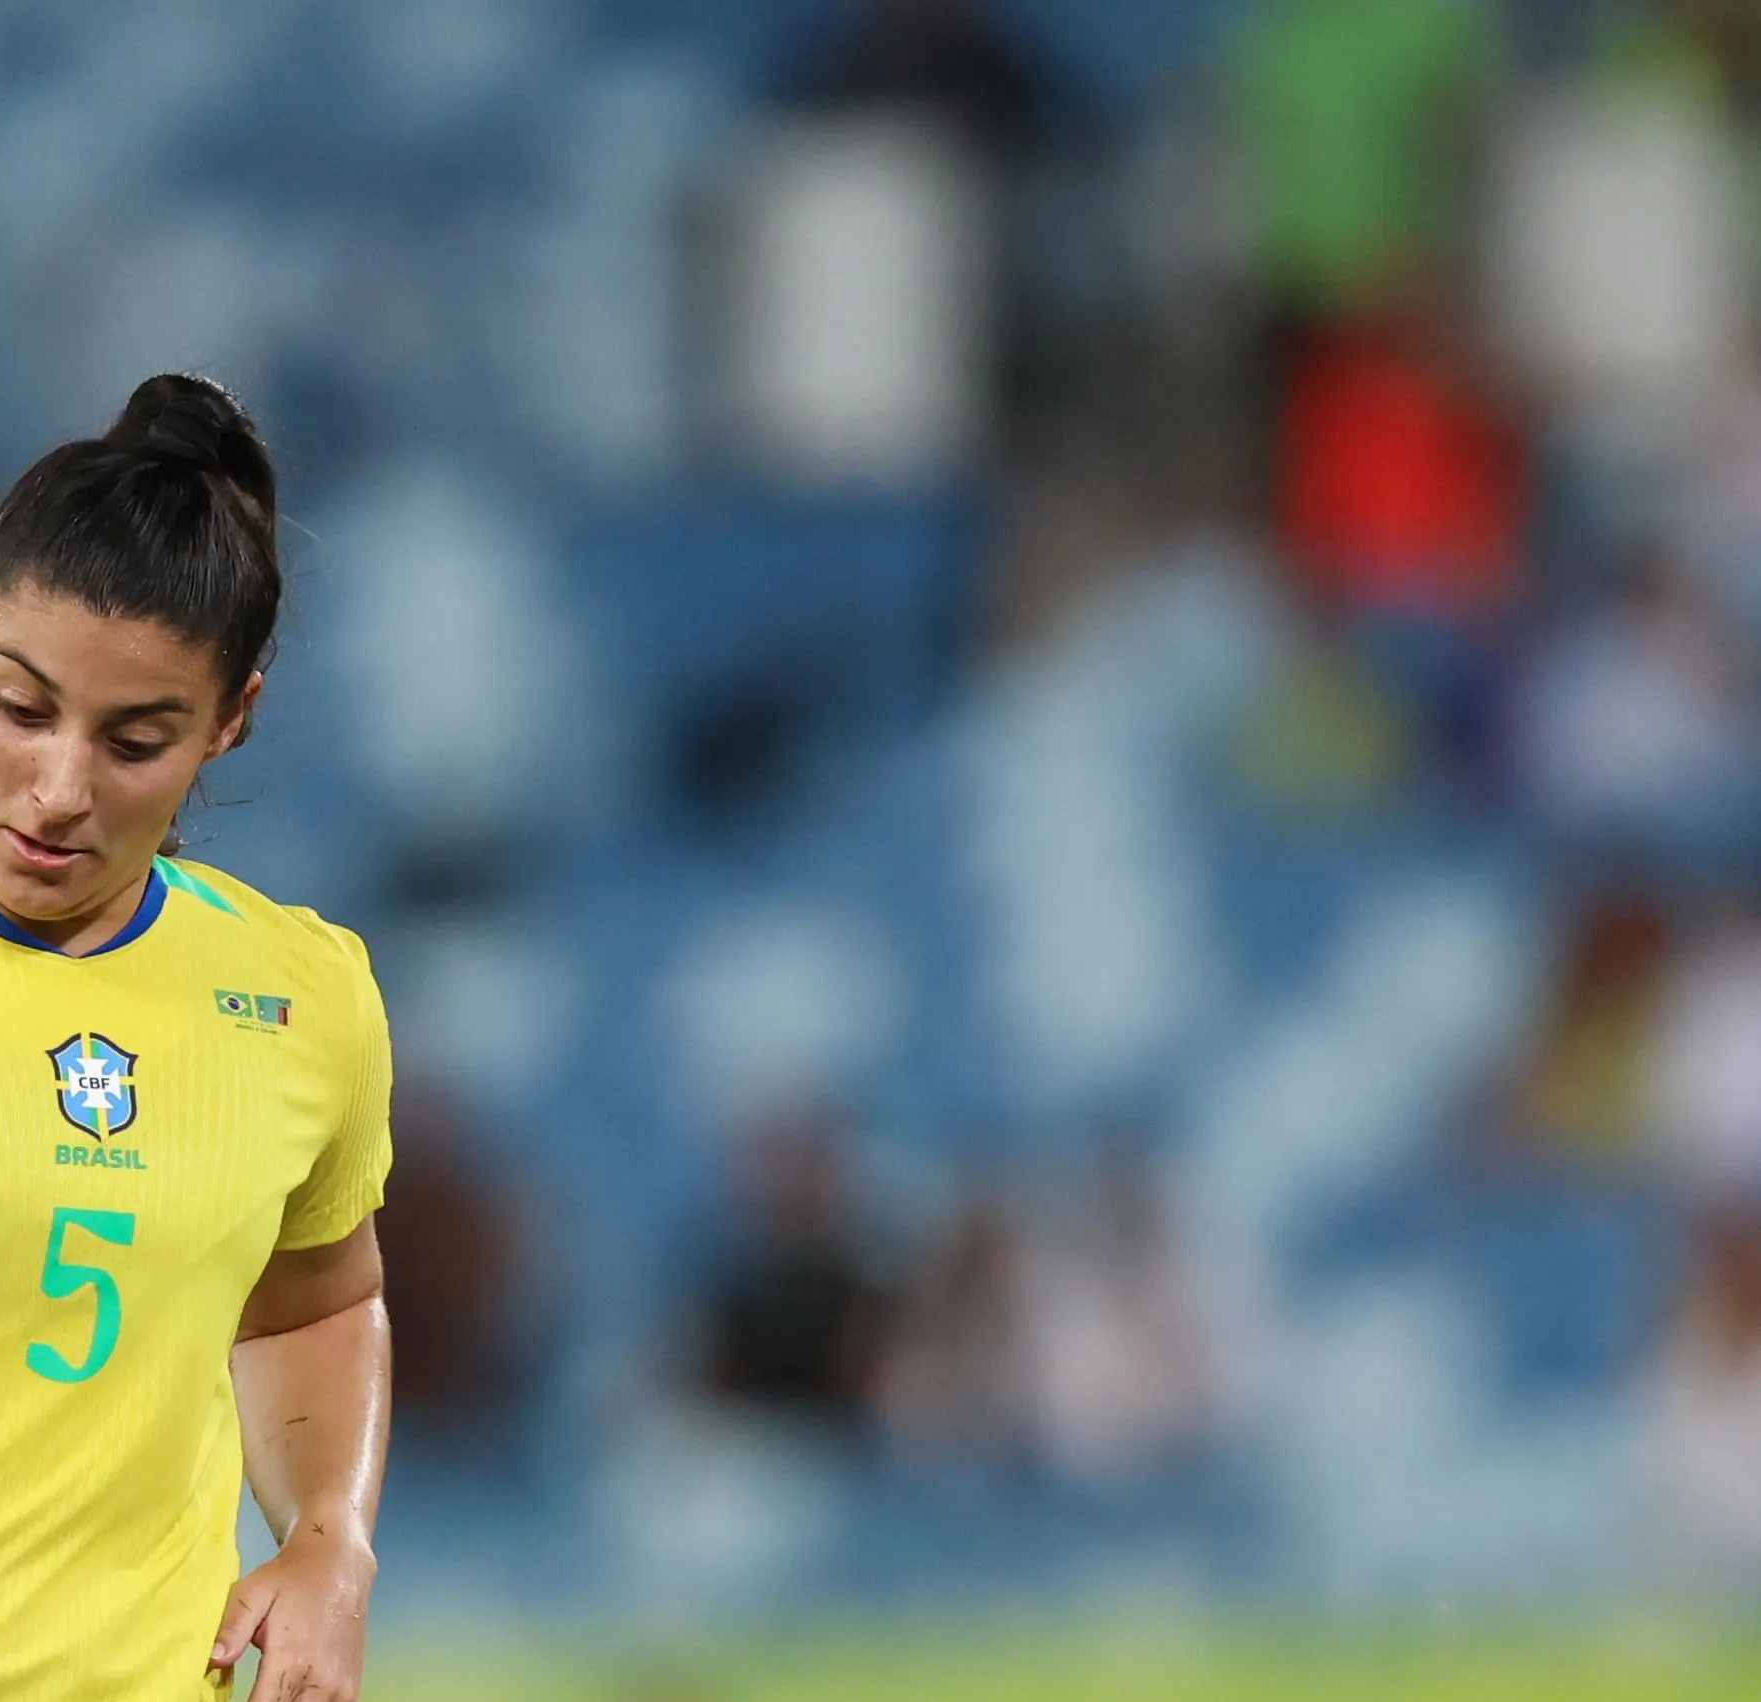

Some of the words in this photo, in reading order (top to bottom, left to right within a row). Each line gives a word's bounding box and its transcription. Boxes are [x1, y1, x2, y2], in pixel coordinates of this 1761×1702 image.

[78, 1076, 110, 1089] CBF
[55, 1144, 147, 1170] BRASIL
[25, 1206, 136, 1384] 5
